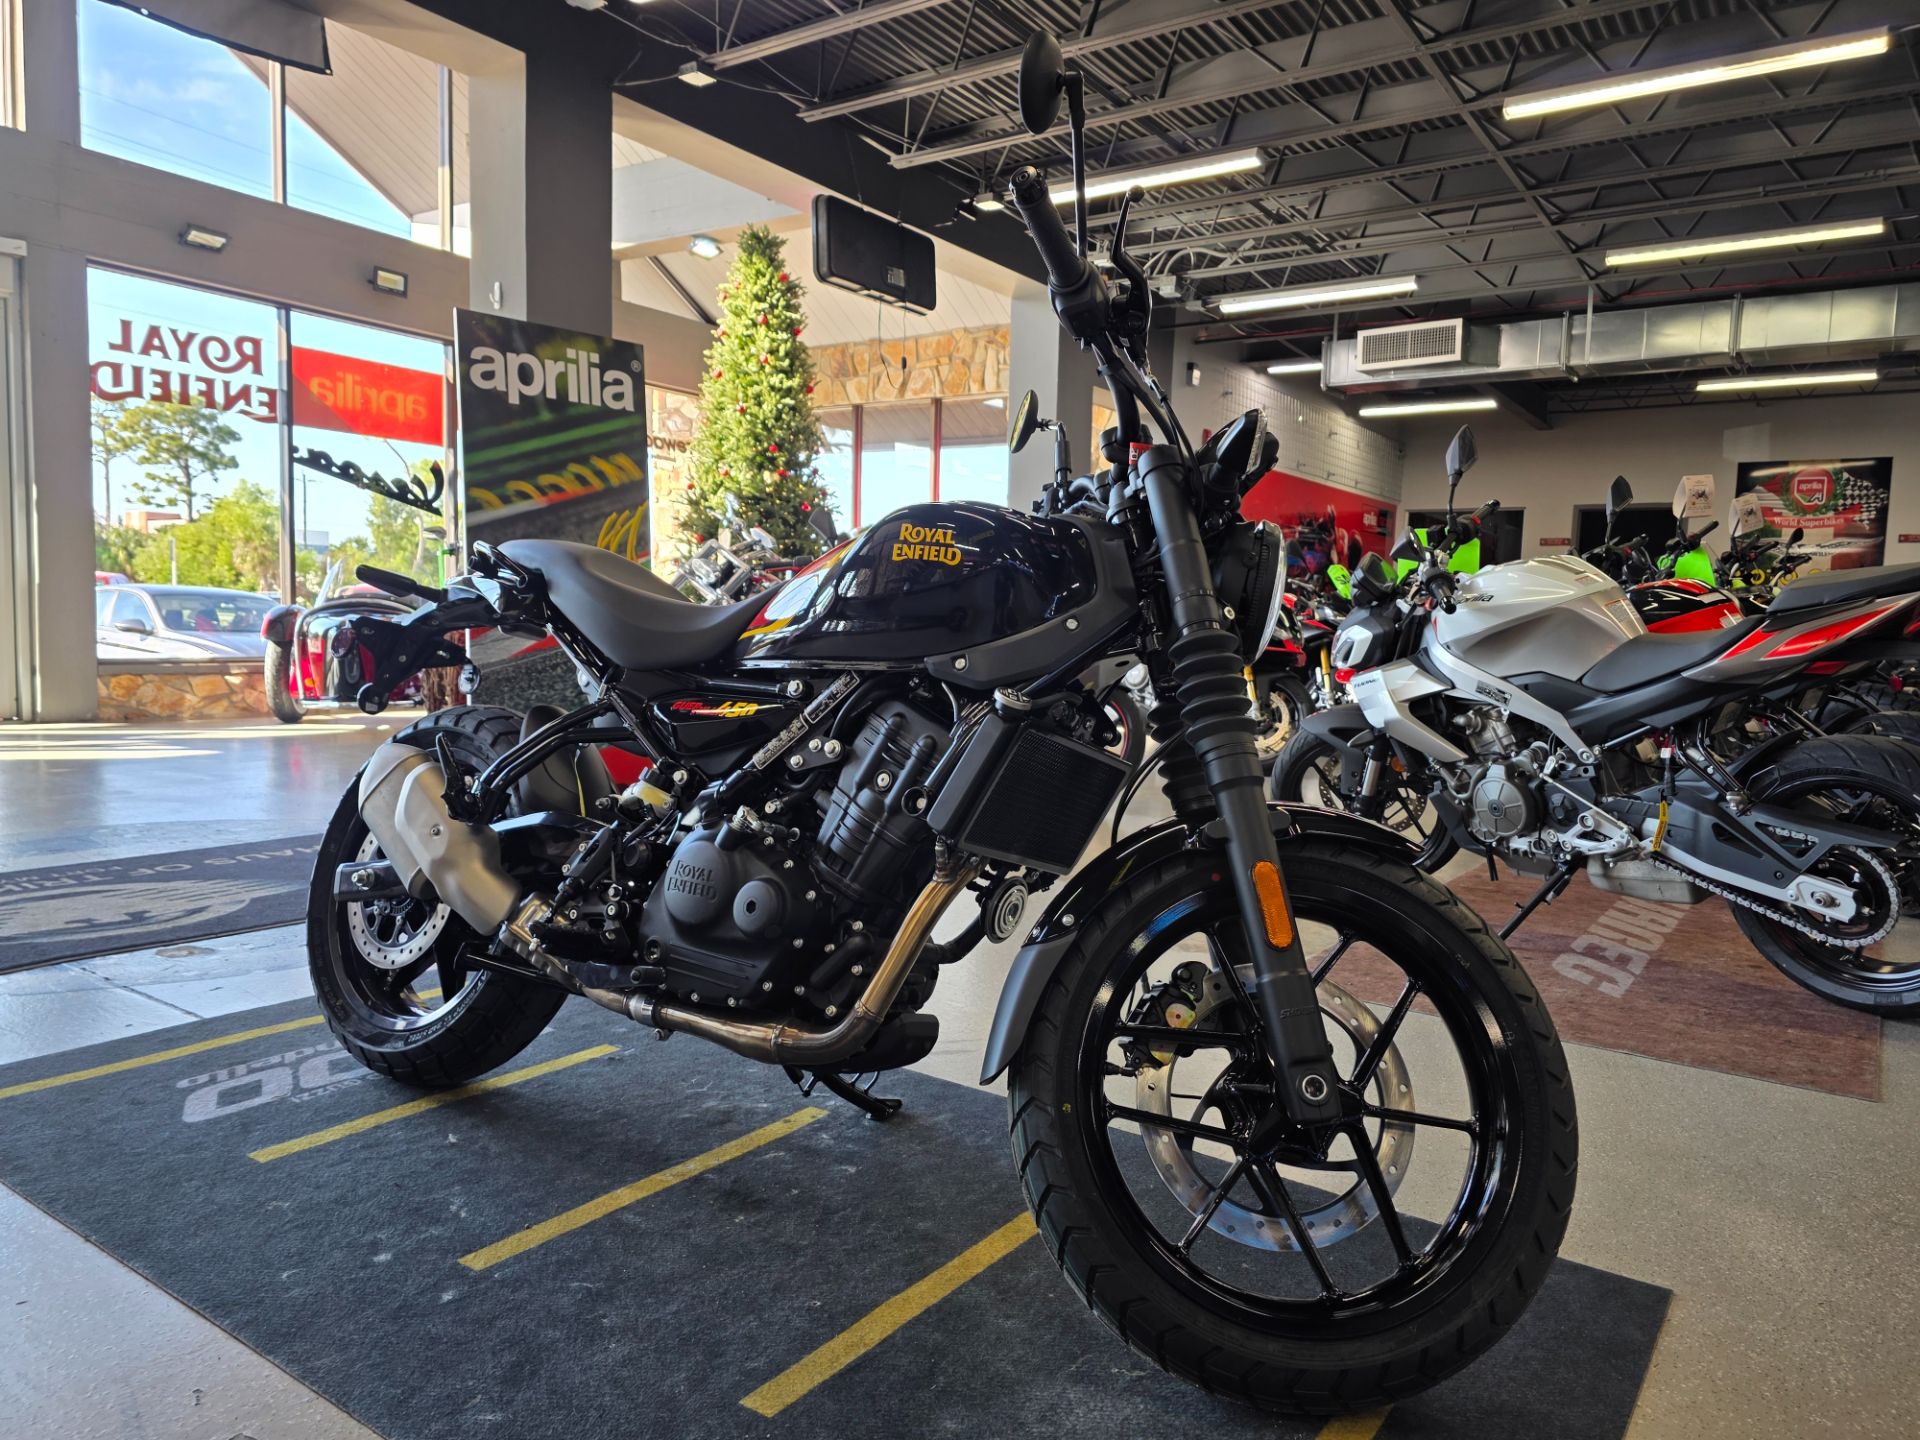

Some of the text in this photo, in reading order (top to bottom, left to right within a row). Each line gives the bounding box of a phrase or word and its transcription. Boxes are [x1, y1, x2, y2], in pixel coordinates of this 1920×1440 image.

[469, 346, 635, 412] aprilia
[1774, 516, 1845, 528] World Superbikes
[899, 523, 955, 544] ROYAL
[892, 543, 962, 566] ENFIELD
[717, 700, 759, 718] 450
[674, 859, 713, 882] ROYAL
[0, 874, 115, 892] TRIK
[667, 877, 719, 903] ENFIELD
